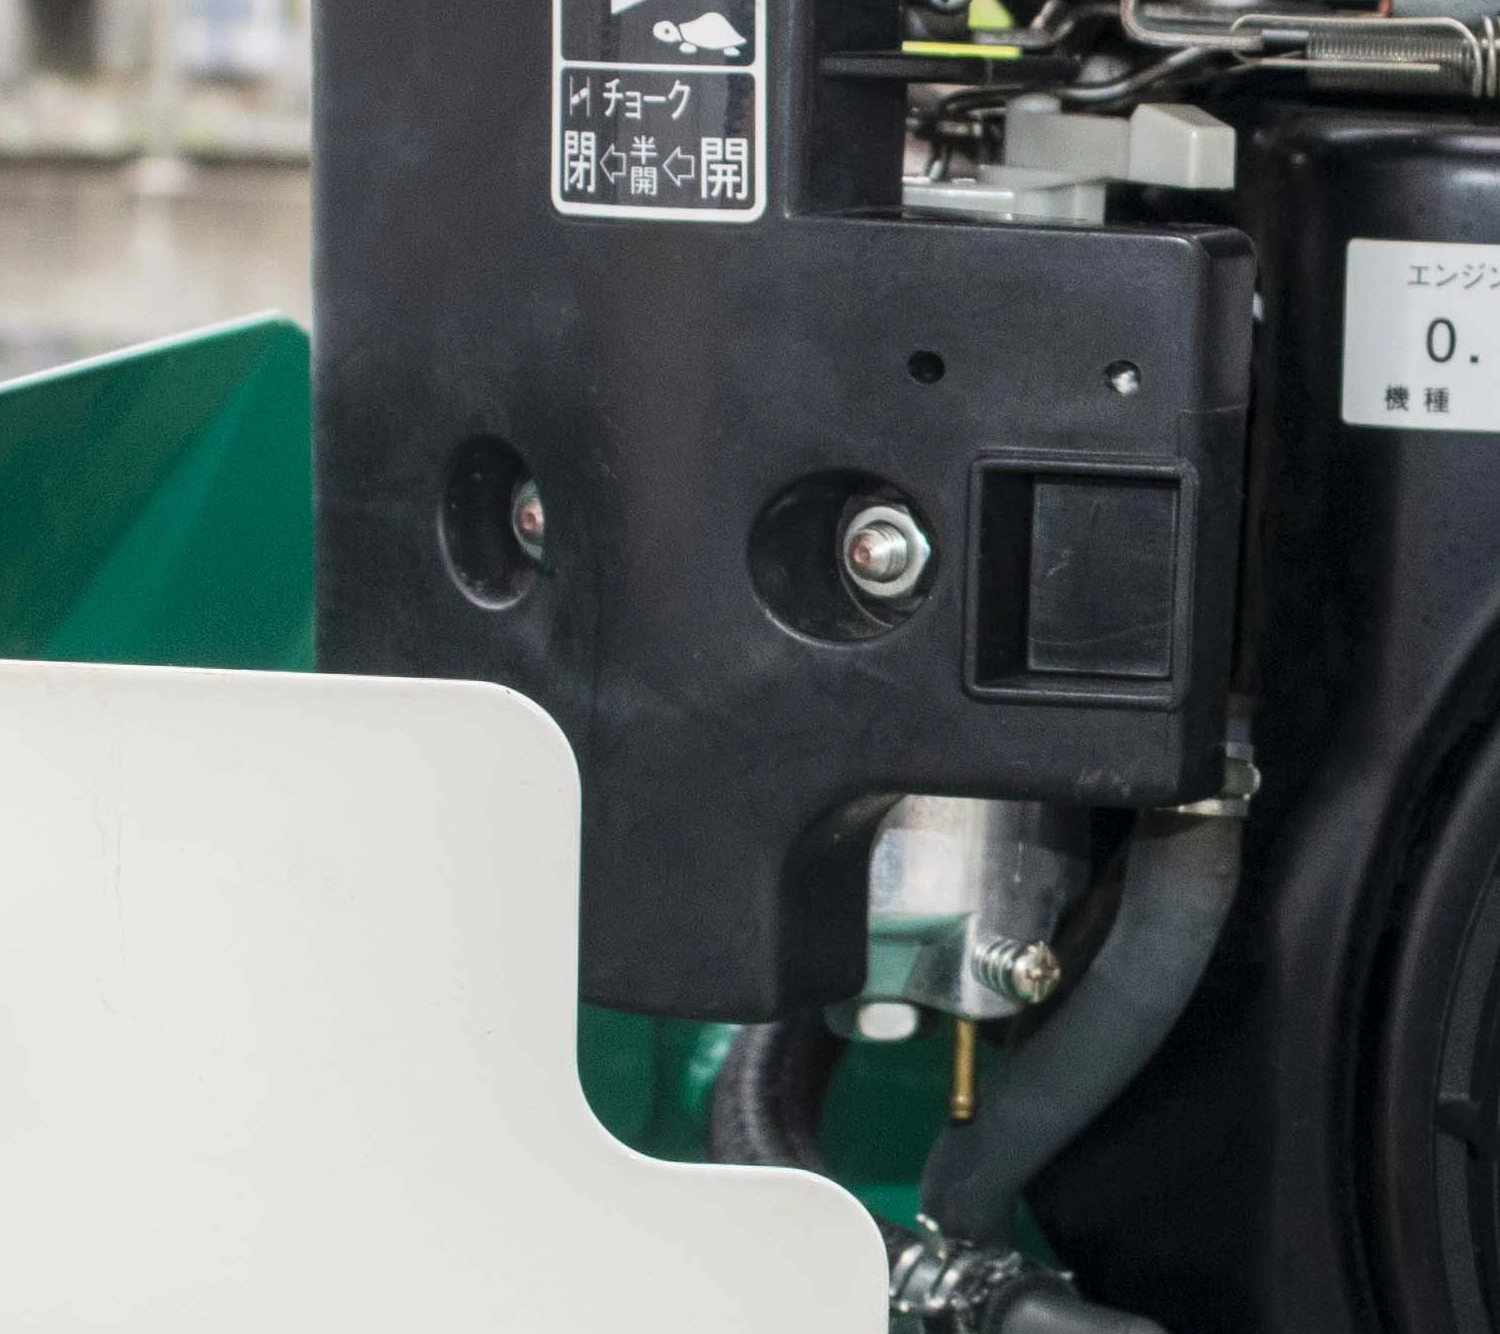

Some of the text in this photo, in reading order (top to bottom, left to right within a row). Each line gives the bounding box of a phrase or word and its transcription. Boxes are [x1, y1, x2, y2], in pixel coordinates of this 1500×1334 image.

[602, 77, 692, 120] チョーク
[564, 129, 596, 194] 閉
[700, 137, 749, 201] 開
